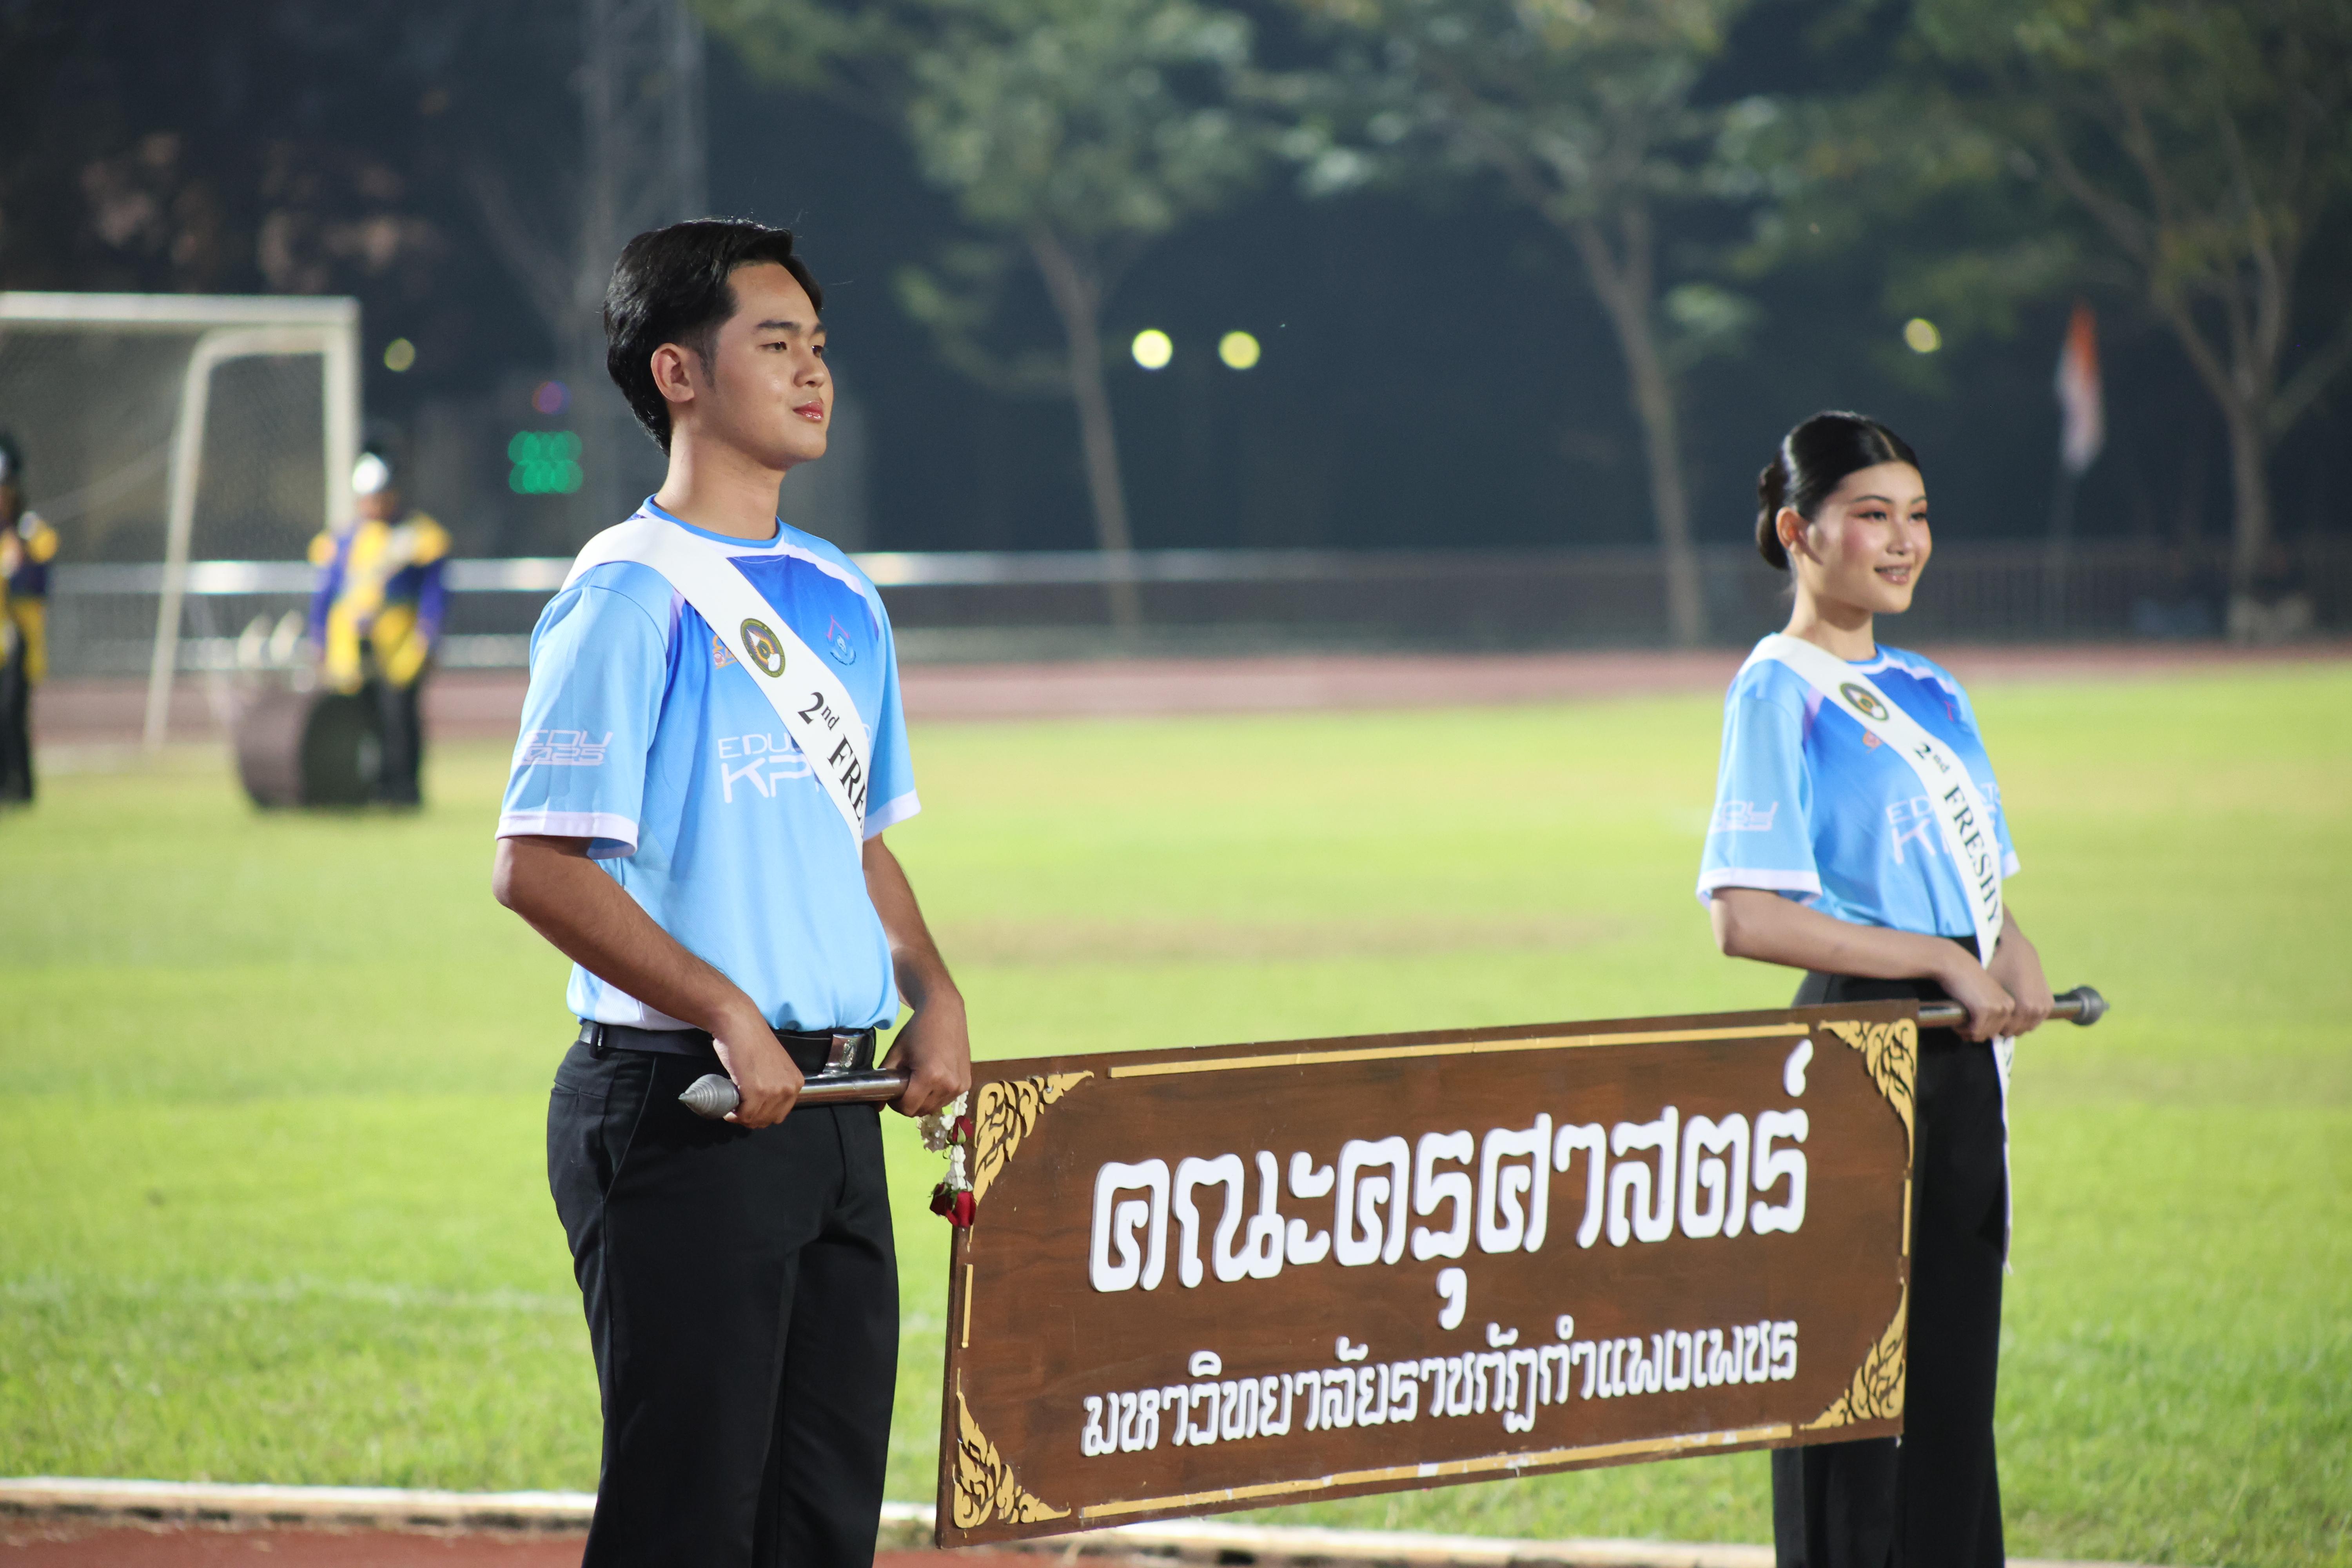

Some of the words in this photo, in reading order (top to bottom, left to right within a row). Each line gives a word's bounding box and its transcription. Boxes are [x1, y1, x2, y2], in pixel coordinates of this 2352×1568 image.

[797, 692, 840, 731] 2nd
[827, 734, 867, 838] FRE
[1943, 784, 1999, 924] FRESHY
[1089, 1038, 1814, 1330] คณะครุศาสตร์
[1080, 1314, 1798, 1457] มหาวิทยาลัยราชภัฏกำแพงเพชร
